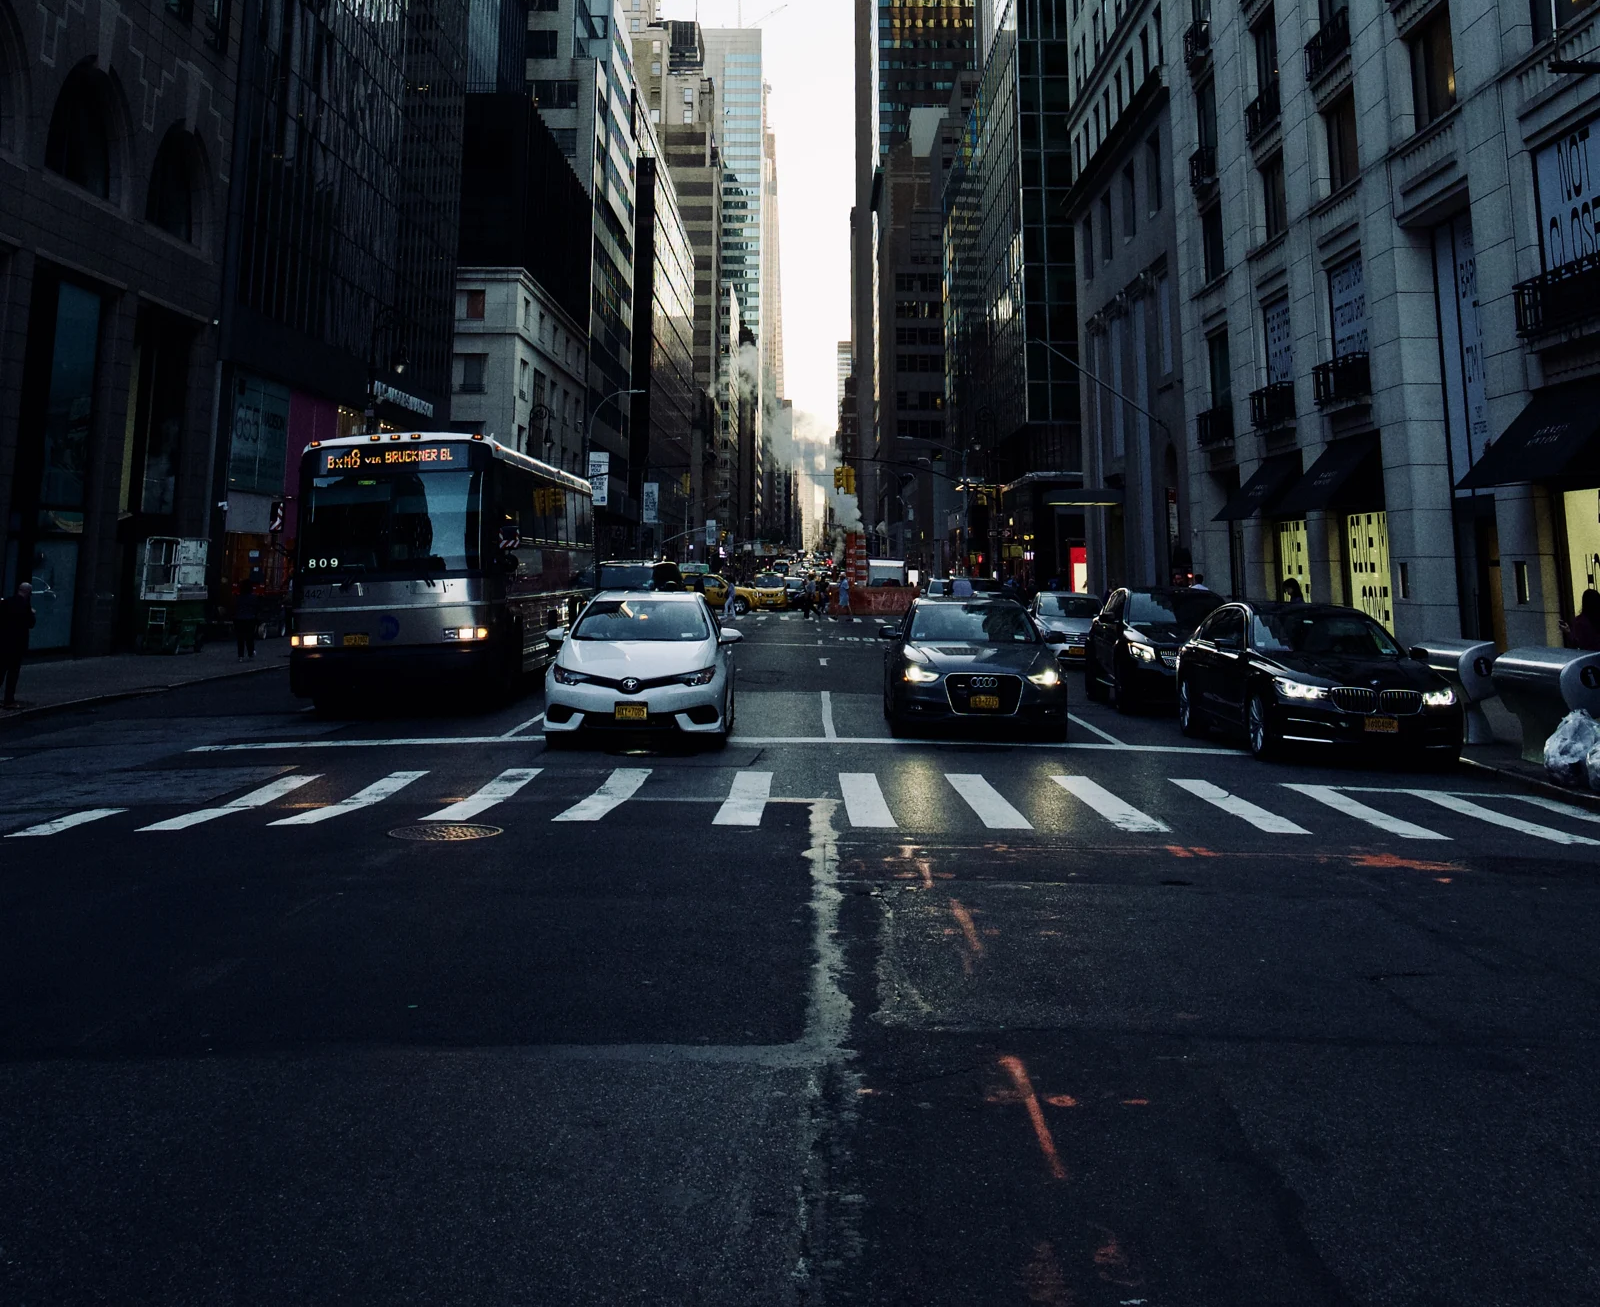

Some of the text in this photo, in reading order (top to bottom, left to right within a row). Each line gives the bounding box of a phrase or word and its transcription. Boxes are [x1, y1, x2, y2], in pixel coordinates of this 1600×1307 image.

[1556, 126, 1591, 204] NOT
[327, 449, 361, 469] BxM8
[385, 449, 438, 463] BRUCKNER
[440, 448, 453, 461] BL
[308, 558, 339, 569] 809
